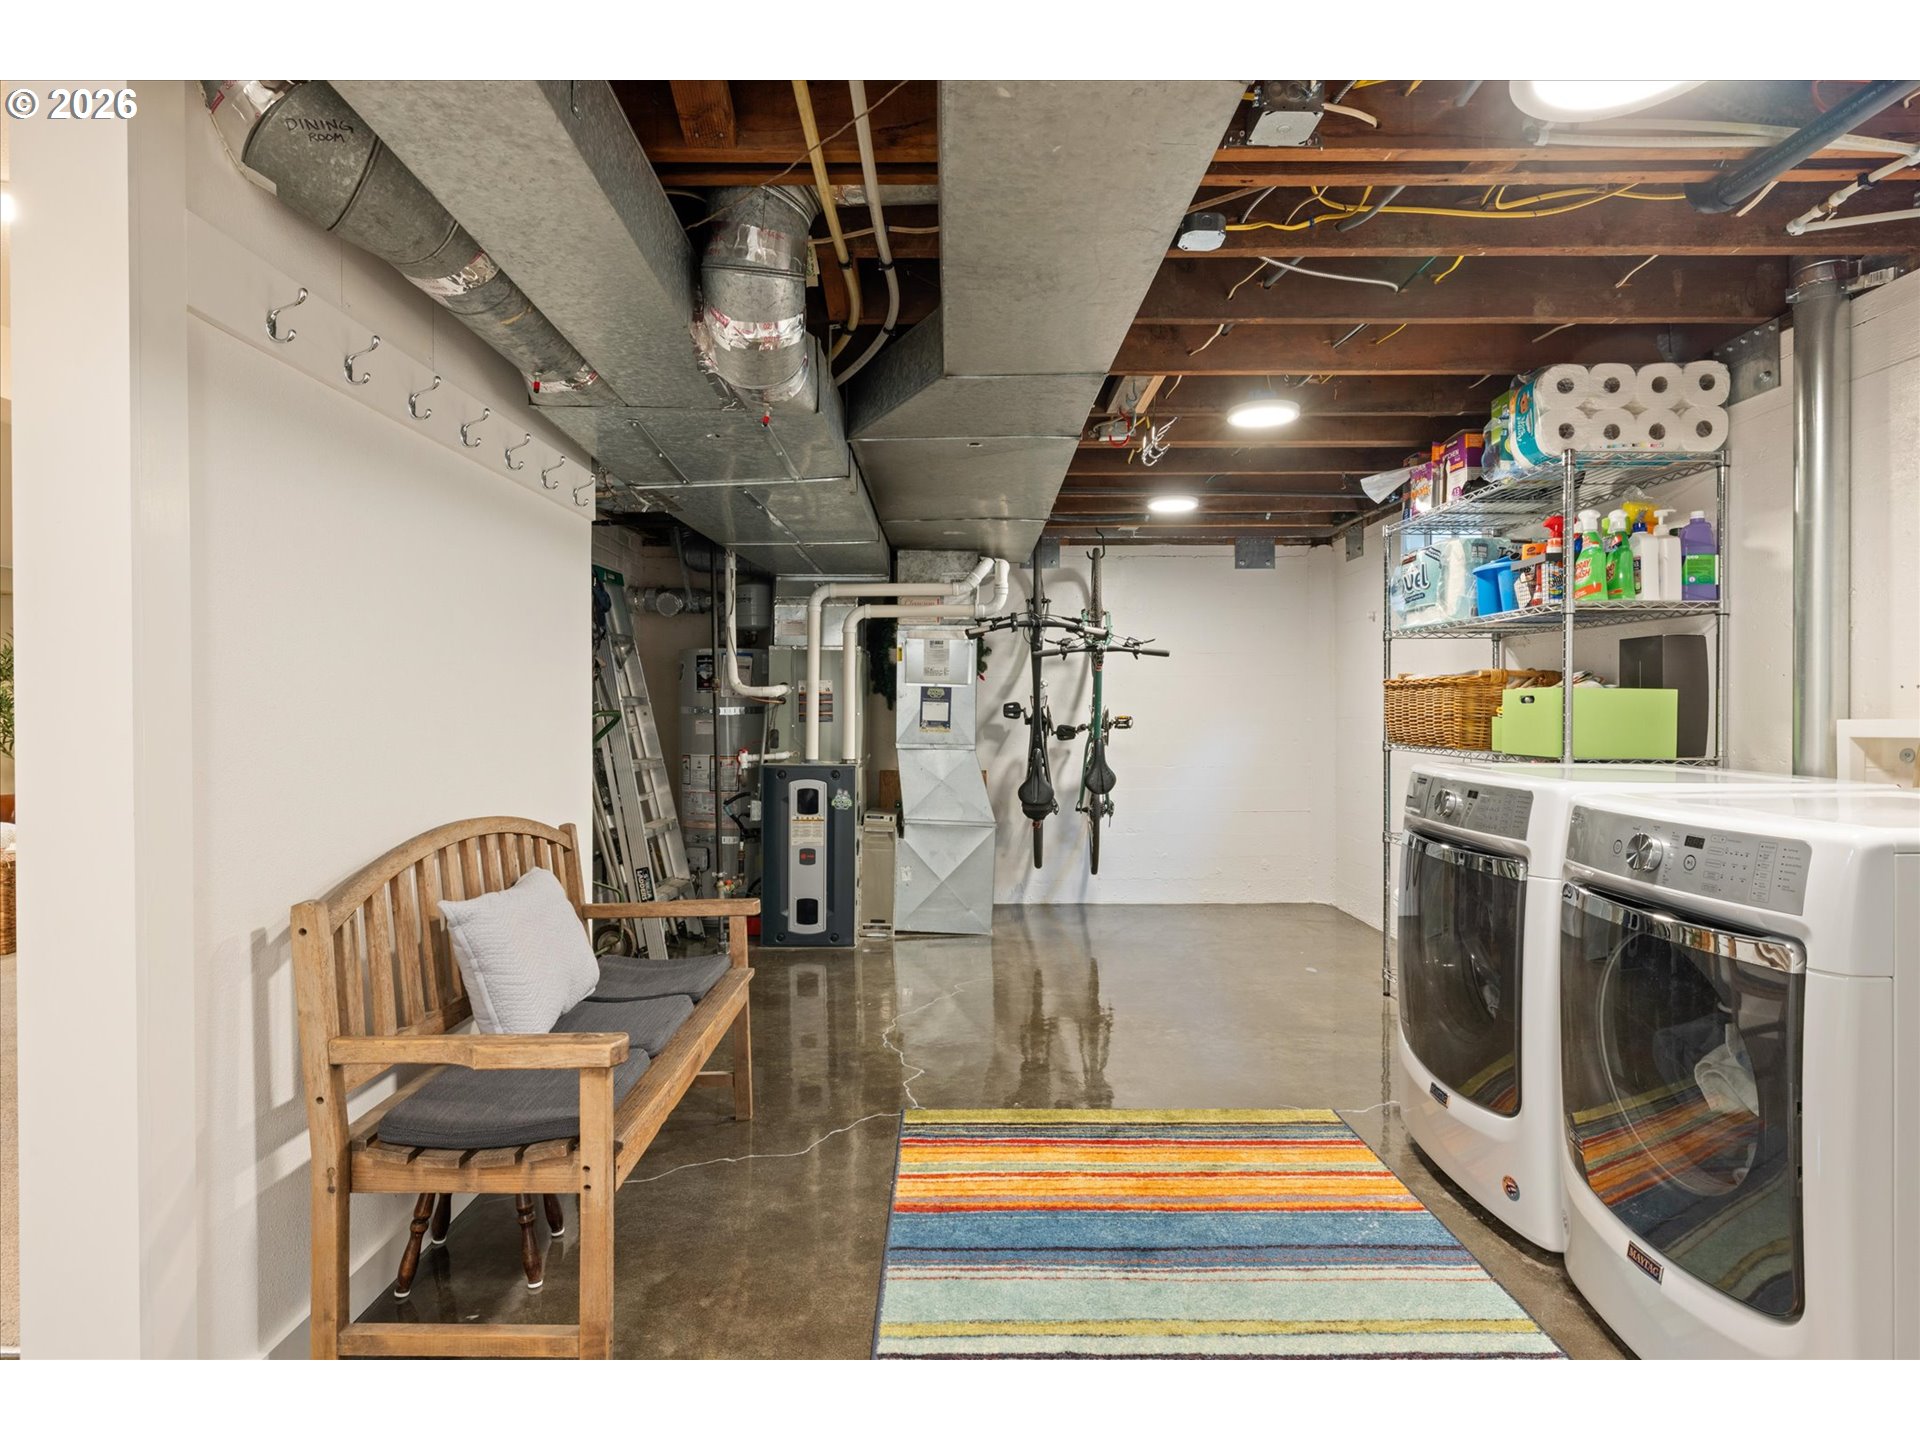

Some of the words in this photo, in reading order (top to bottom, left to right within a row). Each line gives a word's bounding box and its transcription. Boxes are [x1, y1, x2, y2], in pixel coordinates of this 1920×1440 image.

[285, 117, 354, 133] DINING
[308, 132, 345, 143] ROOM
[1629, 1246, 1660, 1278] MAYTAG
